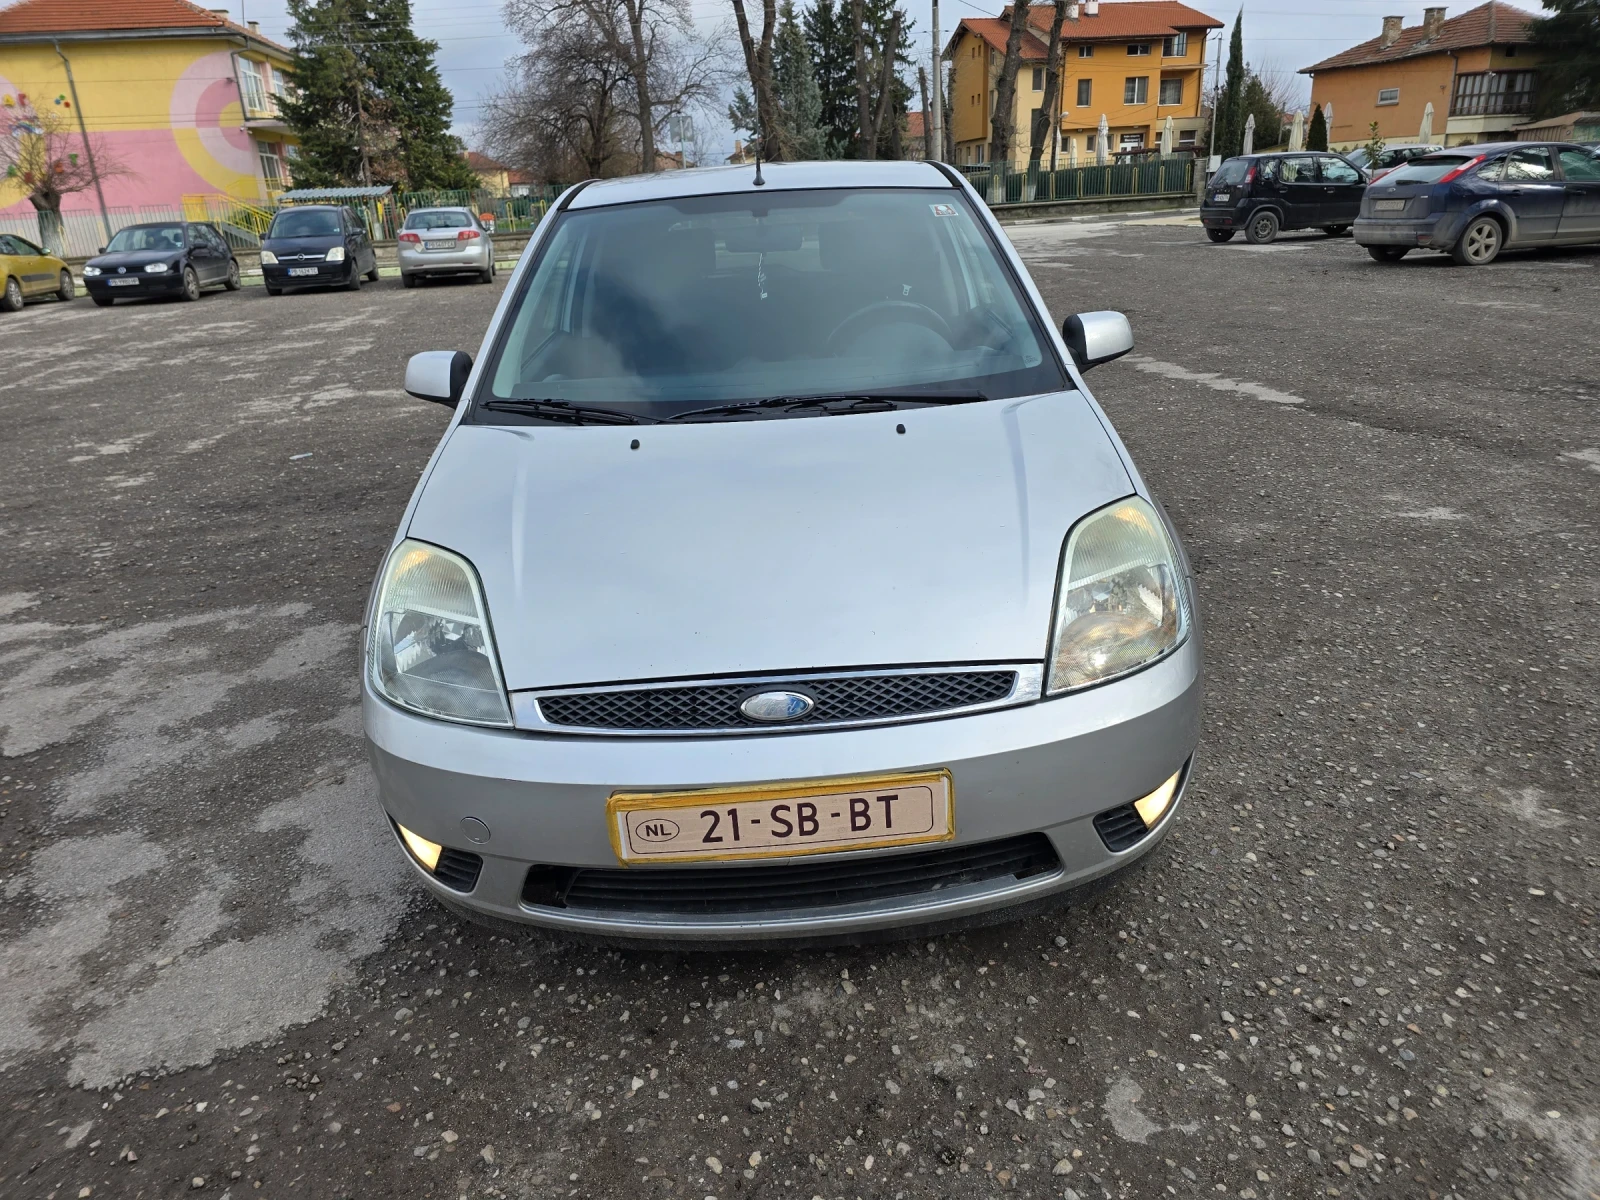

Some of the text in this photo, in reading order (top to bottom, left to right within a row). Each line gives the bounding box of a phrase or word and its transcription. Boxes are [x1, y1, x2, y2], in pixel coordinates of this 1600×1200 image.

[756, 699, 798, 713] Ford
[645, 795, 899, 843] NL 21-SB-BT
